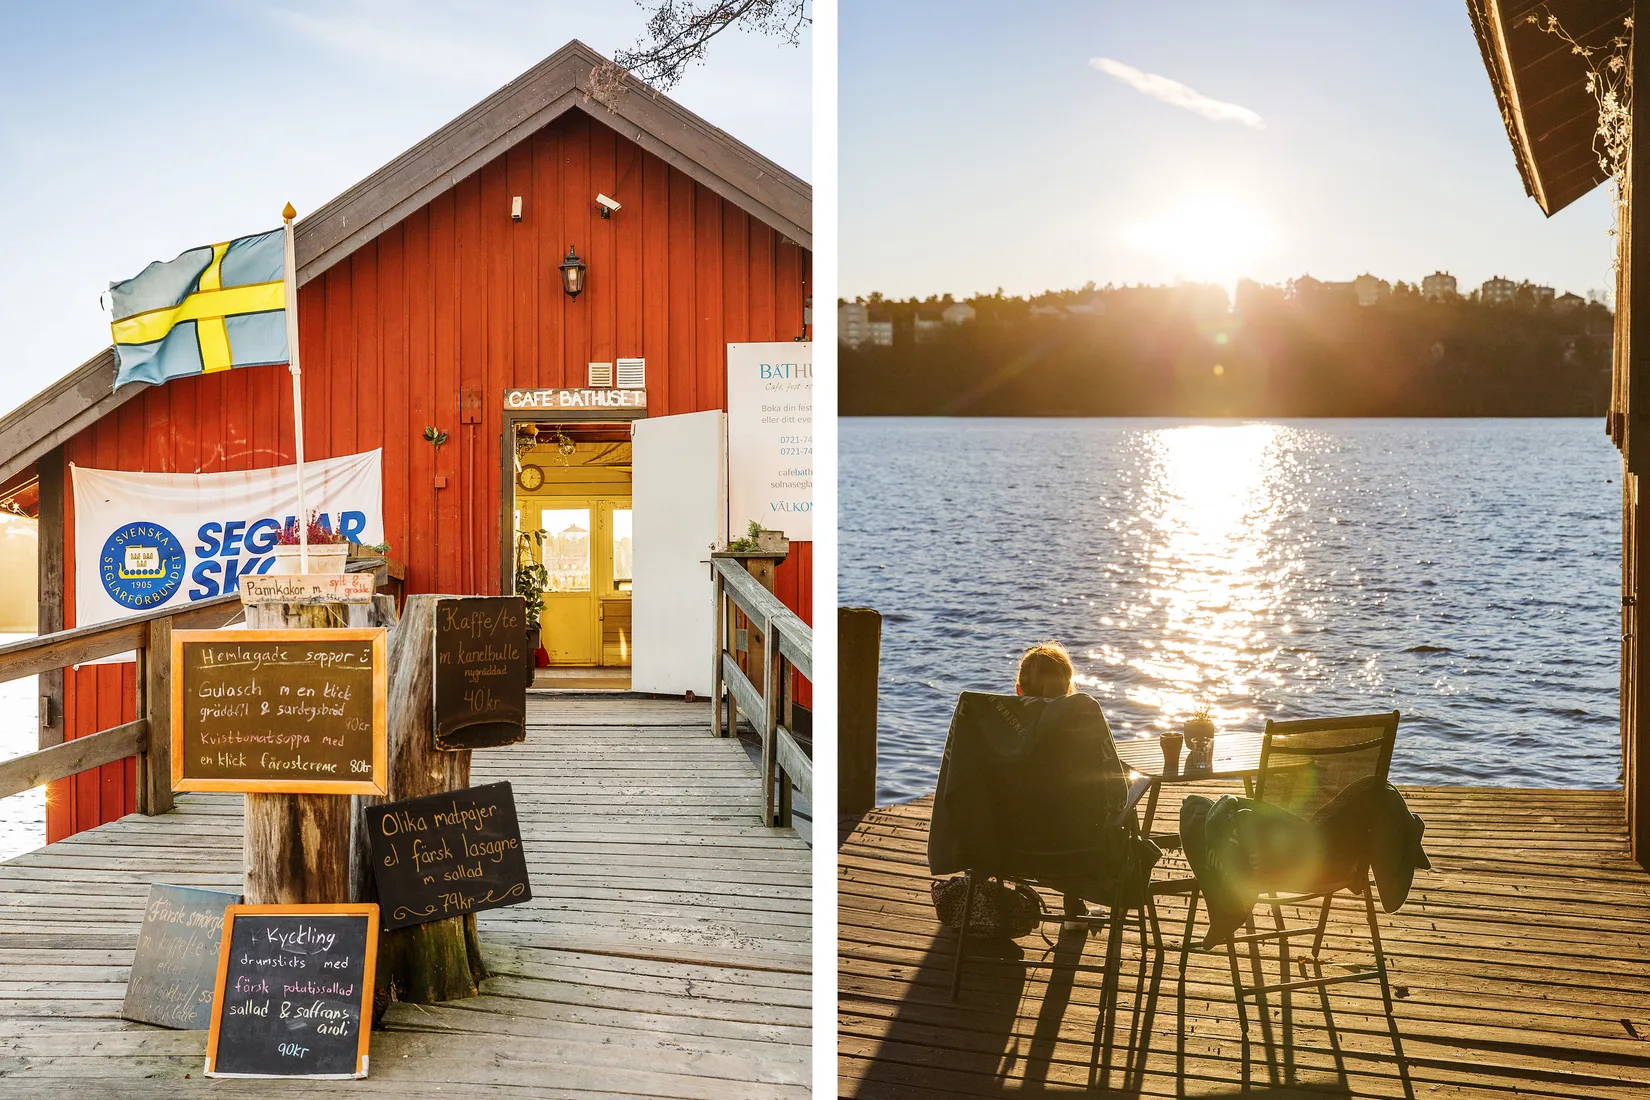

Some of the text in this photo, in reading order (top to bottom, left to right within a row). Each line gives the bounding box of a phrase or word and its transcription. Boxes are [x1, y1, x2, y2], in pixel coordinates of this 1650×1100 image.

[509, 389, 643, 407] CAFÉ BÅTHUSET
[761, 404, 781, 412] Boka
[783, 404, 796, 412] din
[115, 526, 169, 546] SVENSKA
[103, 555, 182, 606] SEGLARFÖRBUNDET
[131, 581, 152, 589] 1905
[329, 574, 346, 592] sylt
[352, 575, 359, 587] &
[442, 605, 518, 638] Kaffe/te
[202, 646, 355, 671] Hemlagade soppor
[457, 641, 520, 664] kanelbulle
[464, 664, 508, 682] nygräddad
[199, 677, 262, 698] Gulasch
[297, 685, 315, 697] en
[324, 682, 352, 701] klick
[200, 702, 249, 722] gräddfil
[260, 701, 271, 716] &
[995, 701, 1028, 740] WHISKE
[200, 730, 345, 750] Kvisttomatsoppa med
[200, 755, 213, 765] en
[218, 752, 247, 768] klick
[382, 801, 497, 836] Olika matpajer
[384, 834, 519, 872] el färsk lasagne
[423, 861, 483, 885] m sallad
[267, 924, 336, 951] Kyckling
[241, 954, 349, 969] drumsticks med
[283, 980, 353, 998] potatissallad
[229, 999, 350, 1020] sallad & saffrans
[317, 1020, 350, 1036] aioli
[277, 1042, 310, 1059] 90kr
